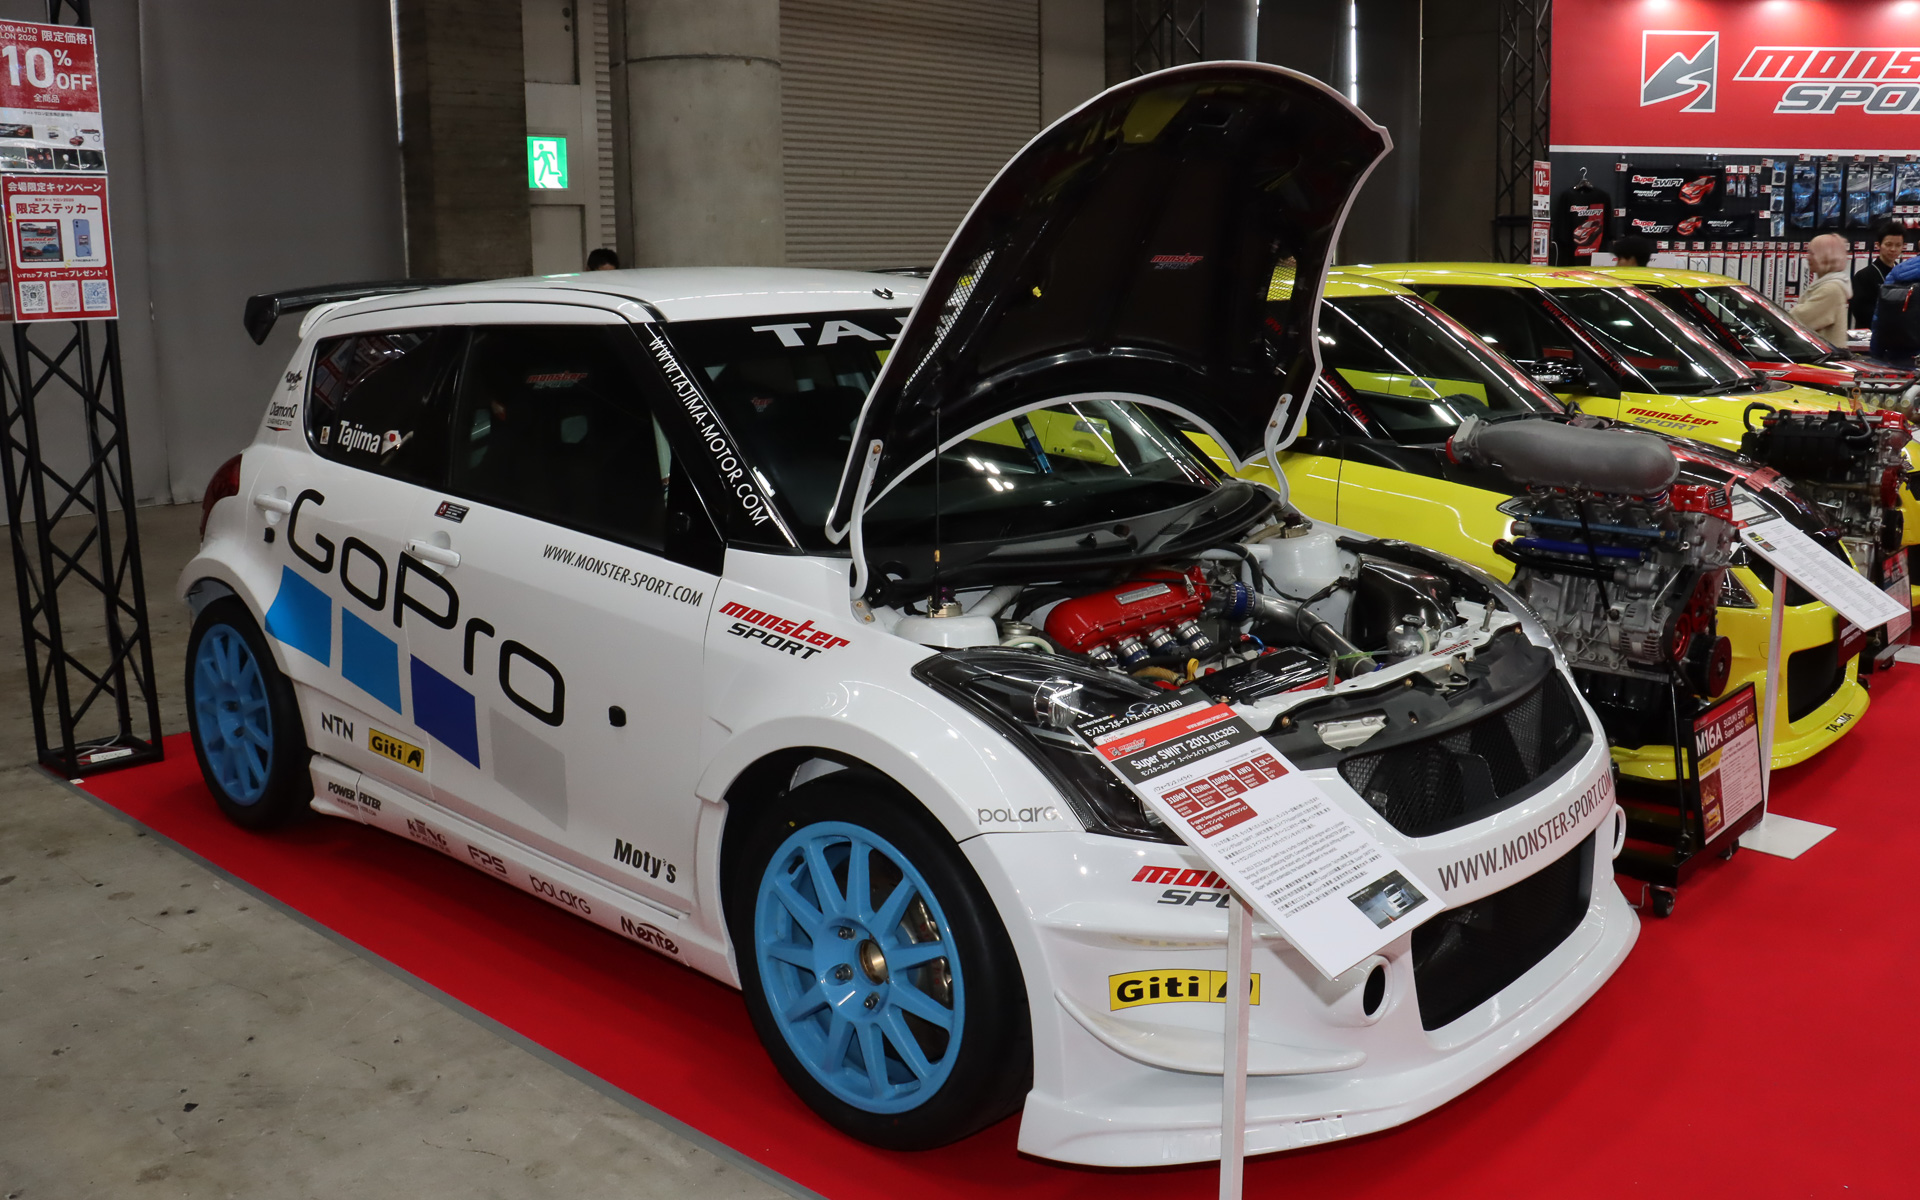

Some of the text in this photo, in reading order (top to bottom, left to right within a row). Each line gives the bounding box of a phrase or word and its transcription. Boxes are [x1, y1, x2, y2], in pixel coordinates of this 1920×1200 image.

[16, 26, 37, 34] AUTO
[18, 33, 37, 41] 2026
[56, 73, 92, 91] OFF
[8, 182, 102, 192] 会場限定キャンペーン
[1632, 175, 1657, 184] Super
[1652, 178, 1683, 188] SWIFT
[16, 203, 98, 214] 限定ステッカー
[1578, 209, 1604, 217] SWIFT
[1632, 219, 1656, 227] Super
[1642, 225, 1673, 233] SWIFT
[1626, 408, 1719, 426] monster
[1633, 416, 1699, 431] SPORT
[337, 420, 381, 453] Tajima
[649, 336, 769, 526] WWW.TAJIMA-MOTOR.COM
[542, 544, 703, 607] WWW.MONSTER-SPORT.COM
[287, 488, 566, 727] GoPro
[719, 601, 850, 649] monster
[727, 622, 822, 660] SPORT
[321, 711, 354, 743] NTN
[1723, 714, 1738, 729] SUZUKI
[1737, 706, 1749, 720] SWIFT
[371, 735, 402, 761] Giti
[1129, 725, 1240, 770] Super SWIFT 2013 [ZC32S]
[1695, 722, 1723, 757] M16A
[1235, 765, 1253, 775] AWD
[328, 782, 355, 801] POWER
[359, 792, 382, 812] FILTER
[1164, 791, 1188, 804] 310kW
[1188, 782, 1211, 794] 453Nm
[1438, 767, 1612, 892] WWW.MONSTER-SPORT.COM
[467, 844, 507, 874] FPS
[614, 838, 676, 884] Moty's
[1116, 975, 1199, 1003] Giti
